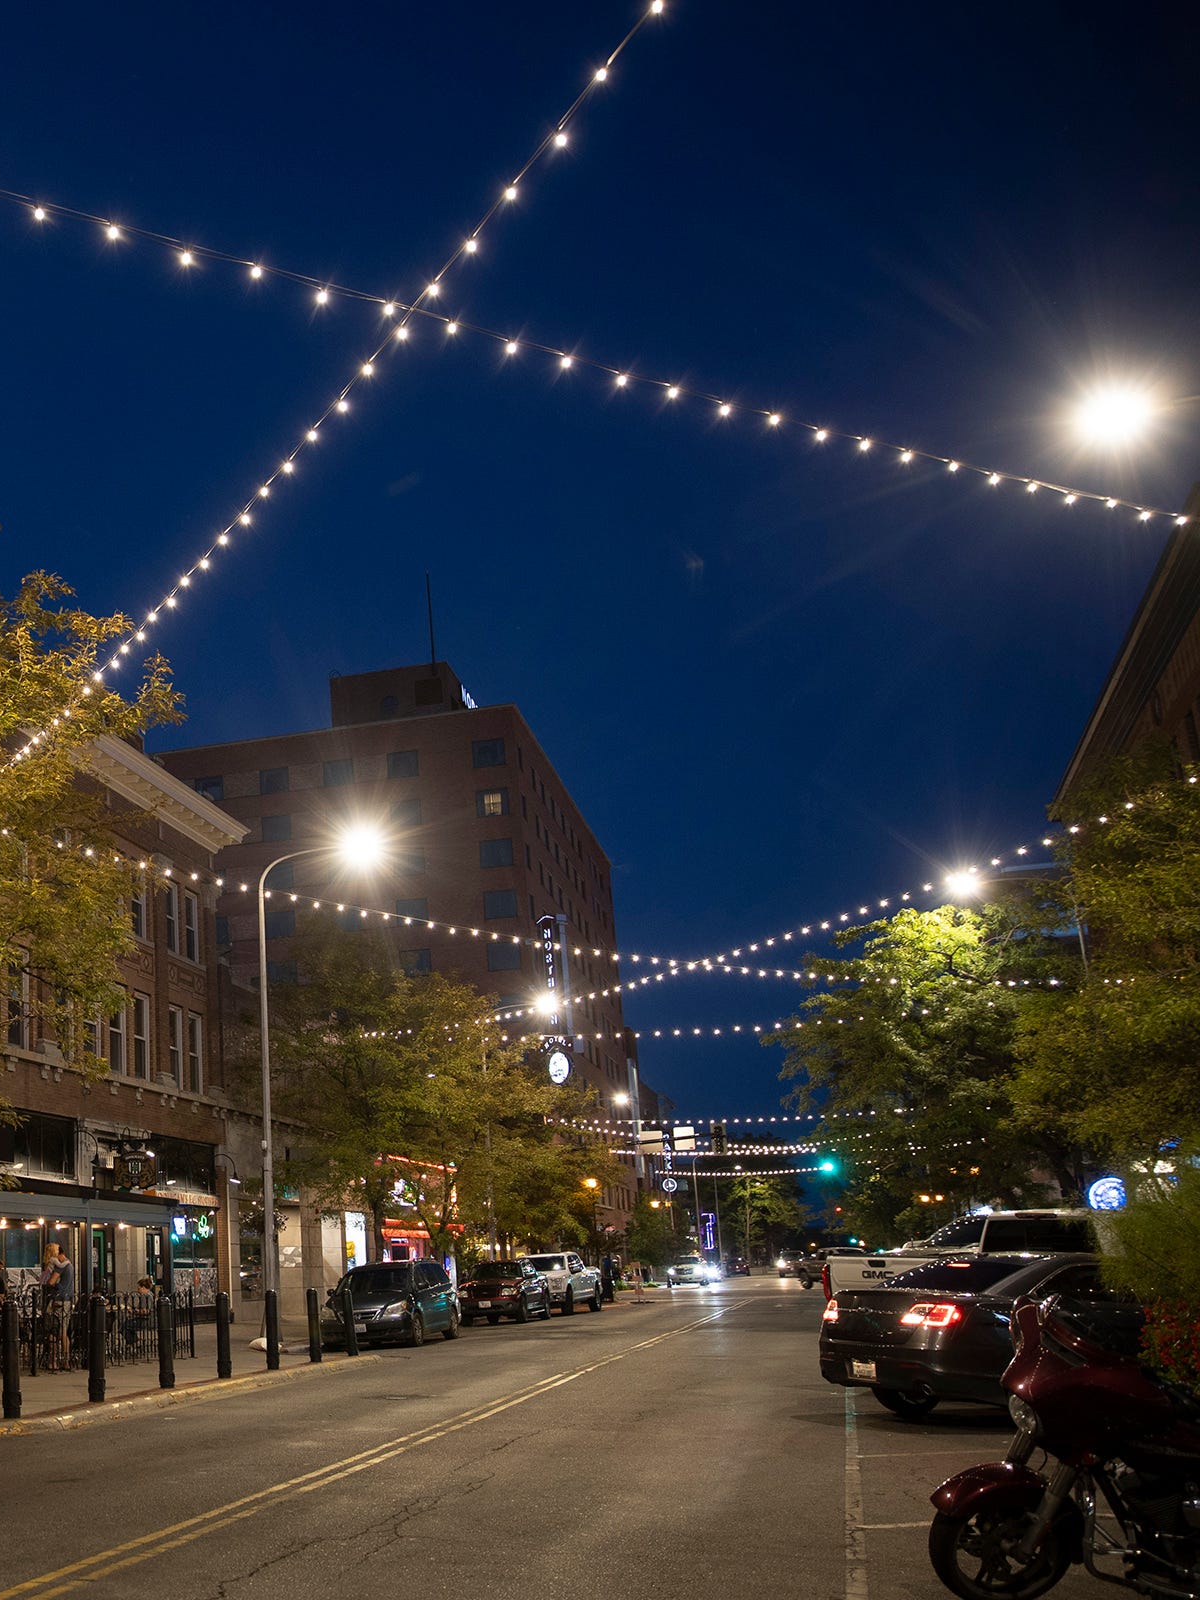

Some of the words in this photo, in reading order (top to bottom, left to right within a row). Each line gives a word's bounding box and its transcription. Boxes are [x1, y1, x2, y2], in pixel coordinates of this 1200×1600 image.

[543, 928, 558, 1026] NORTHN
[544, 1035, 567, 1050] HOTEL
[862, 1270, 895, 1280] GMC
